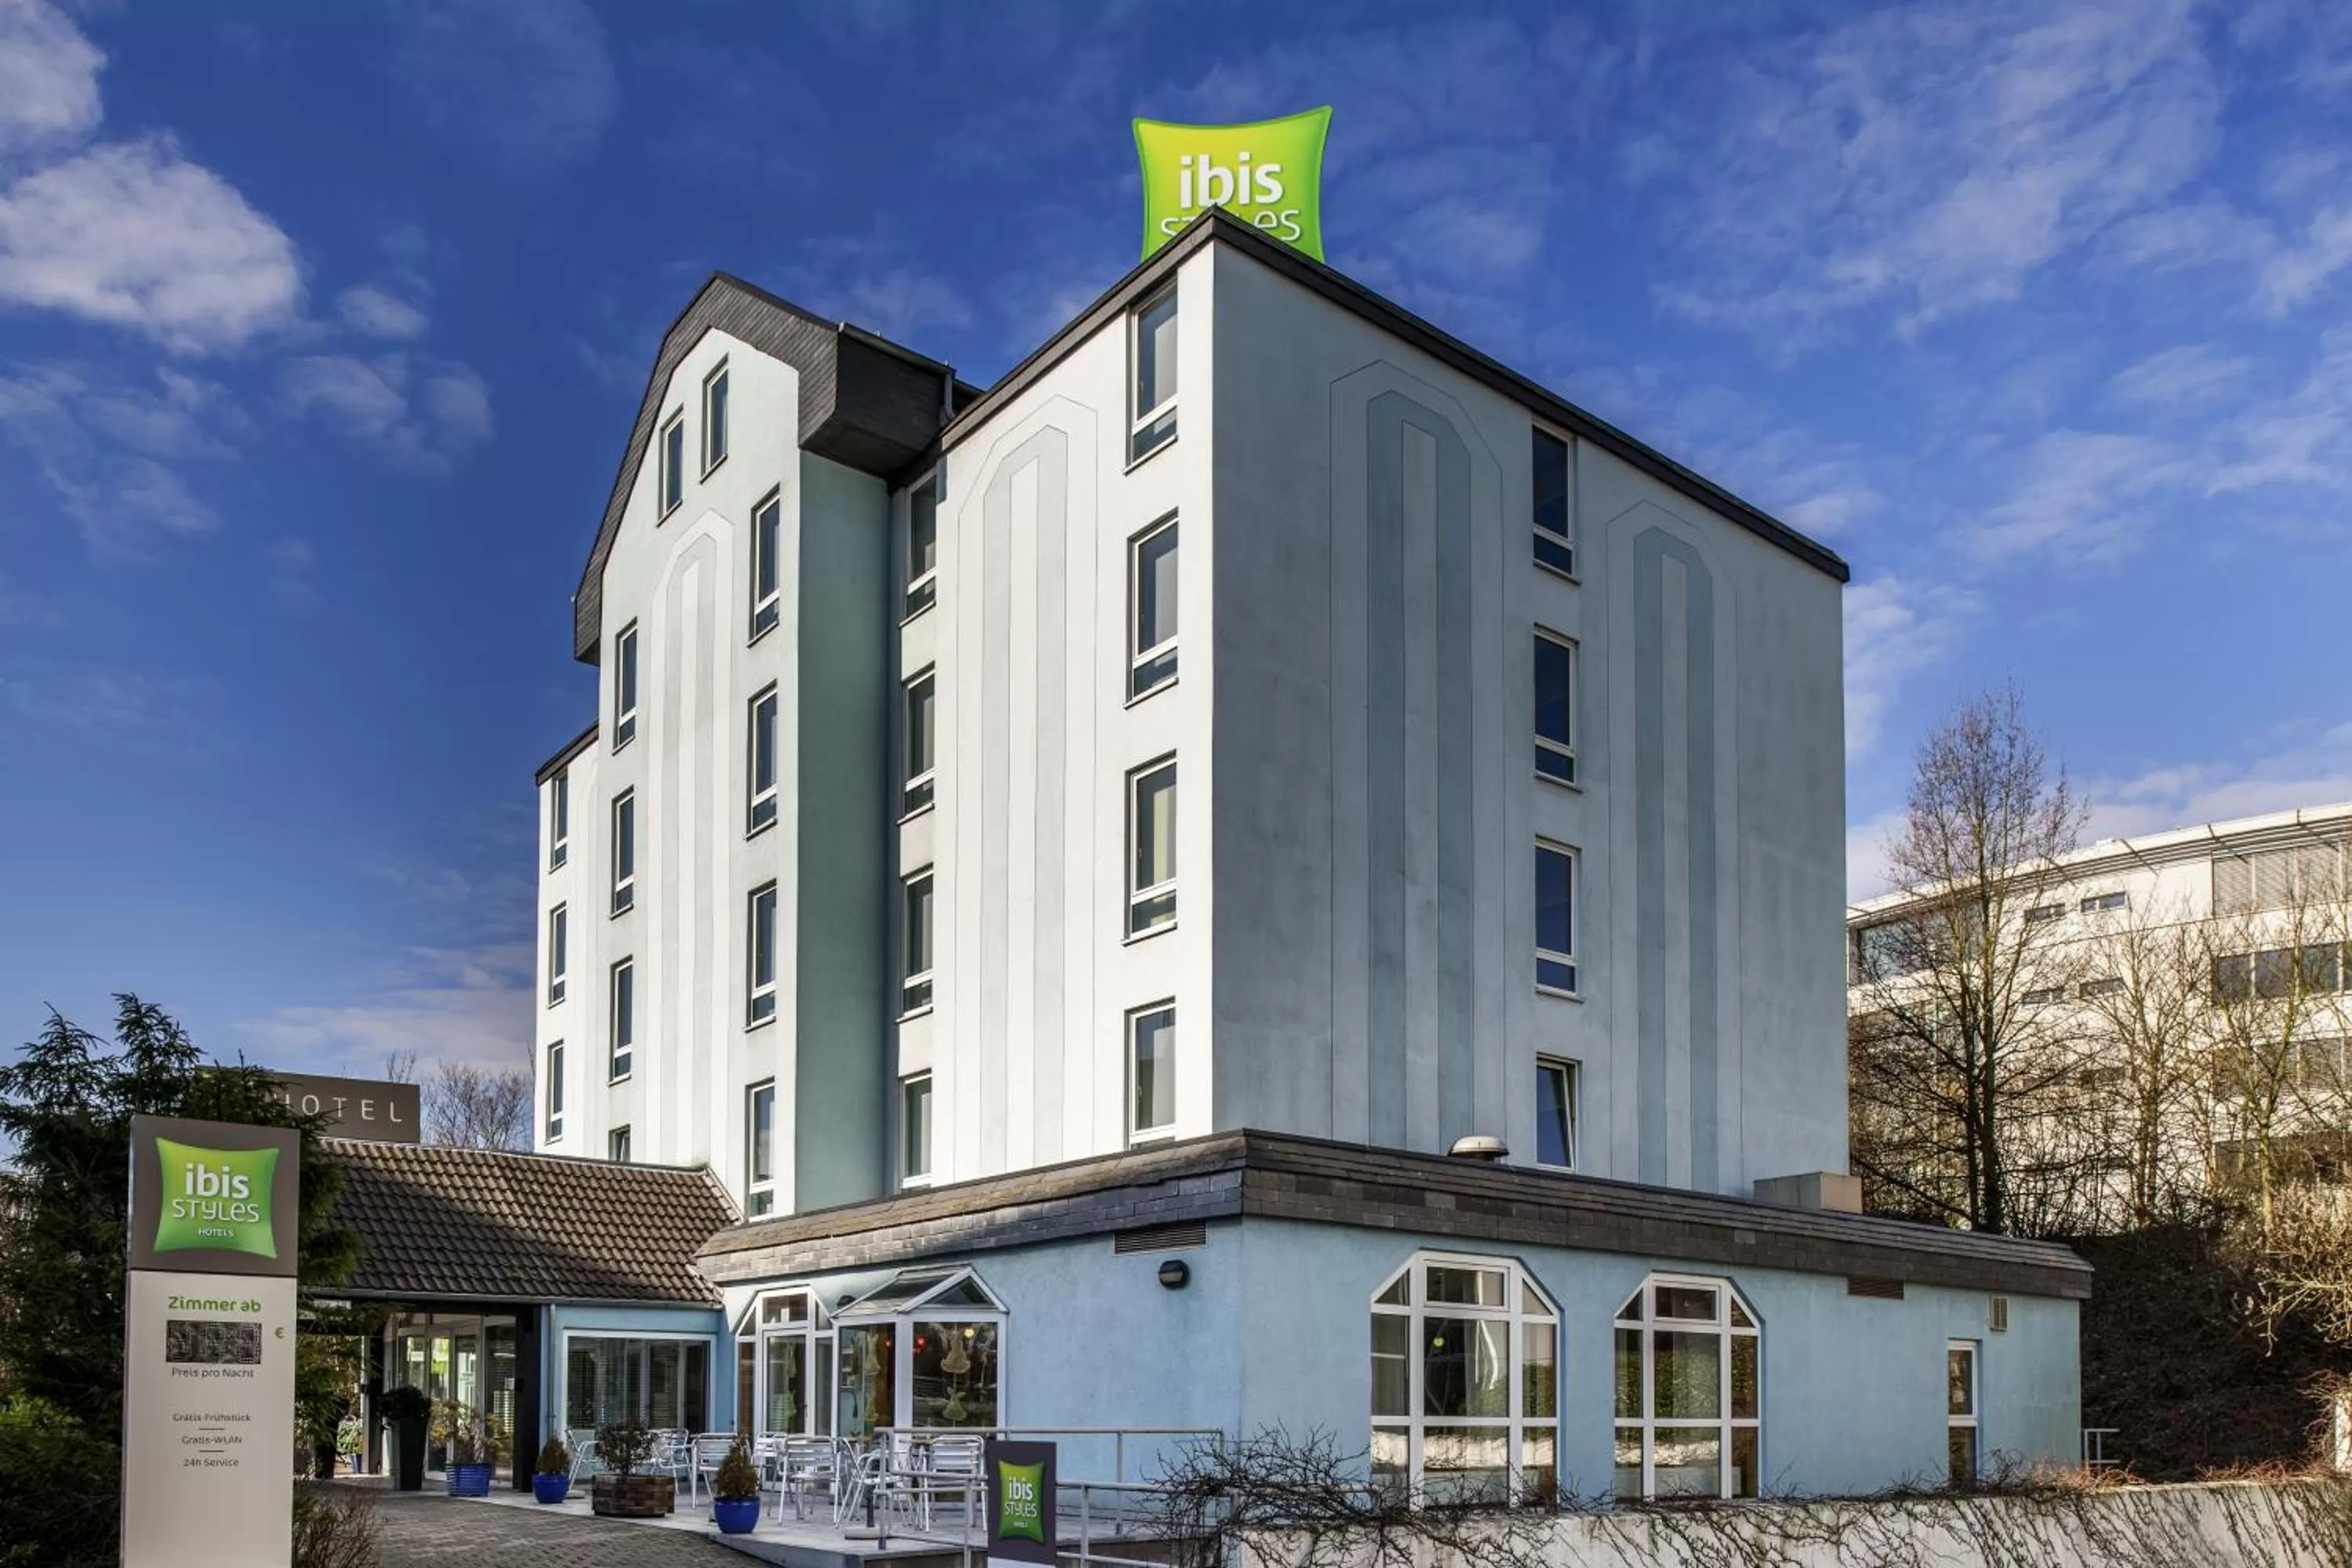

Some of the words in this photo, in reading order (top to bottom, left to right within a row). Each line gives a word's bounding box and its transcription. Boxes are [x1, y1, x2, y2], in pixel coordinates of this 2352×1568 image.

[1179, 151, 1283, 209] ibis
[184, 1163, 250, 1200] ibis
[198, 1227, 234, 1238] HOTELS
[168, 1296, 238, 1312] Zimmer
[240, 1298, 261, 1312] ab
[274, 1327, 285, 1339] €
[172, 1367, 199, 1377] Preis
[201, 1370, 221, 1378] pro
[222, 1368, 255, 1378] Nacht
[202, 1458, 239, 1467] Service
[1009, 1476, 1033, 1501] ibis
